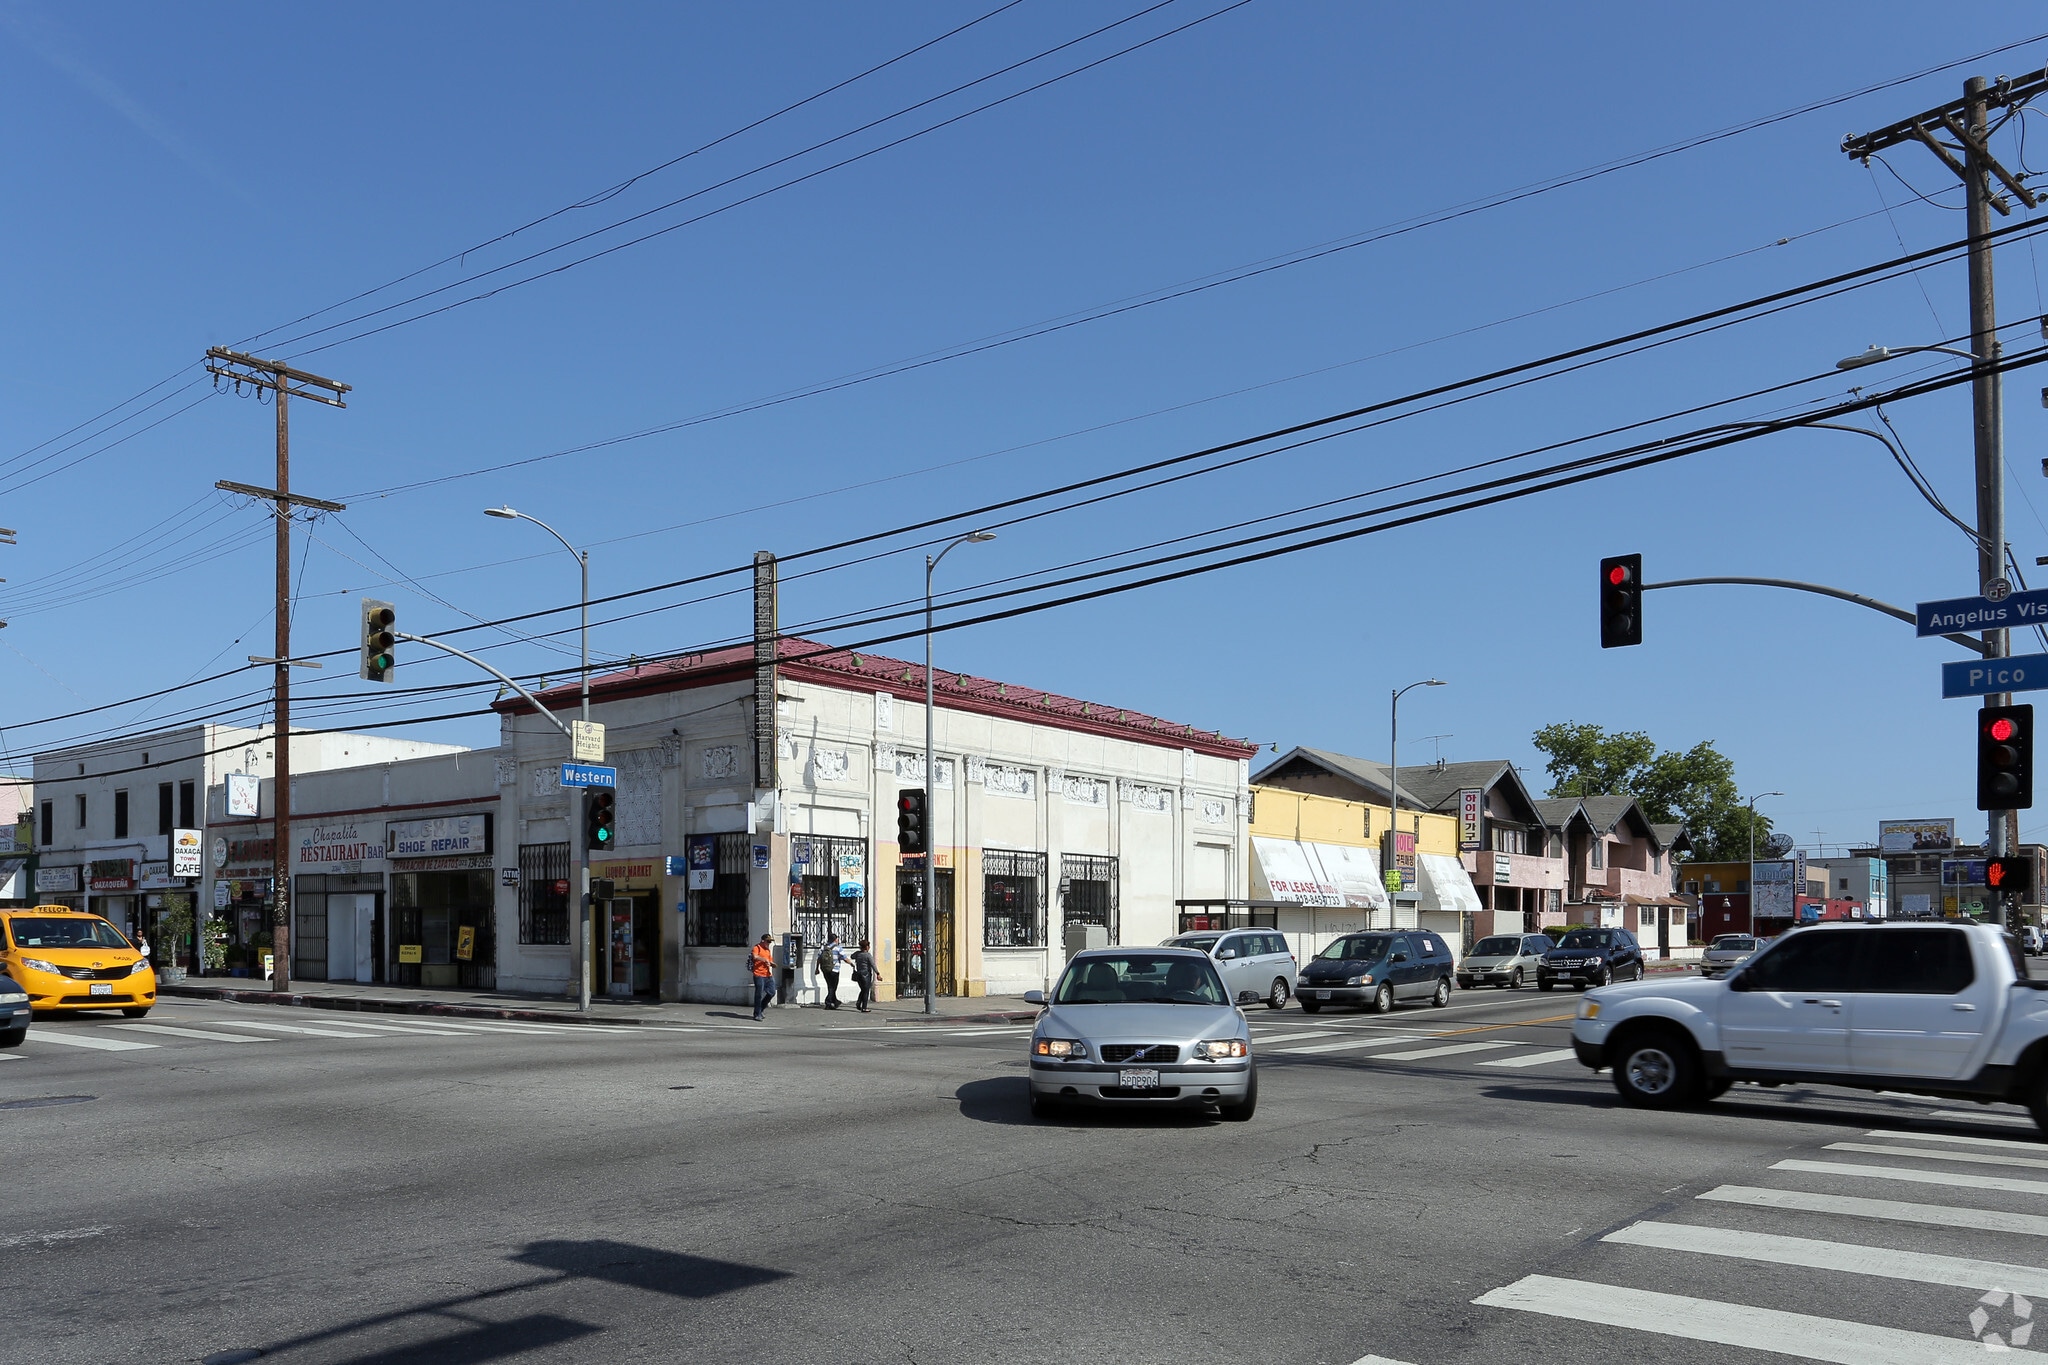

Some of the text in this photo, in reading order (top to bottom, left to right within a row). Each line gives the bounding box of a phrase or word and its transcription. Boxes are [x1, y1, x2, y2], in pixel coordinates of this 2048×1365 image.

[1930, 609, 2007, 628] Angelus
[1970, 669, 2025, 686] Pico
[577, 734, 600, 742] Harvard
[577, 741, 600, 749] Heights
[565, 769, 612, 784] Western
[1465, 794, 1476, 840] 하이디가구
[313, 824, 358, 844] Chapalita
[1885, 825, 1947, 834] entourage
[399, 841, 426, 853] SHOE
[431, 837, 470, 851] REPAIR
[300, 843, 384, 862] RESTAURANT BAR
[175, 864, 201, 873] CAFE
[503, 870, 518, 878] ATM
[628, 865, 652, 877] MARKET
[95, 879, 128, 888] OAXAQUEÑA
[1270, 880, 1289, 892] FOR
[1289, 881, 1317, 893] LEASE
